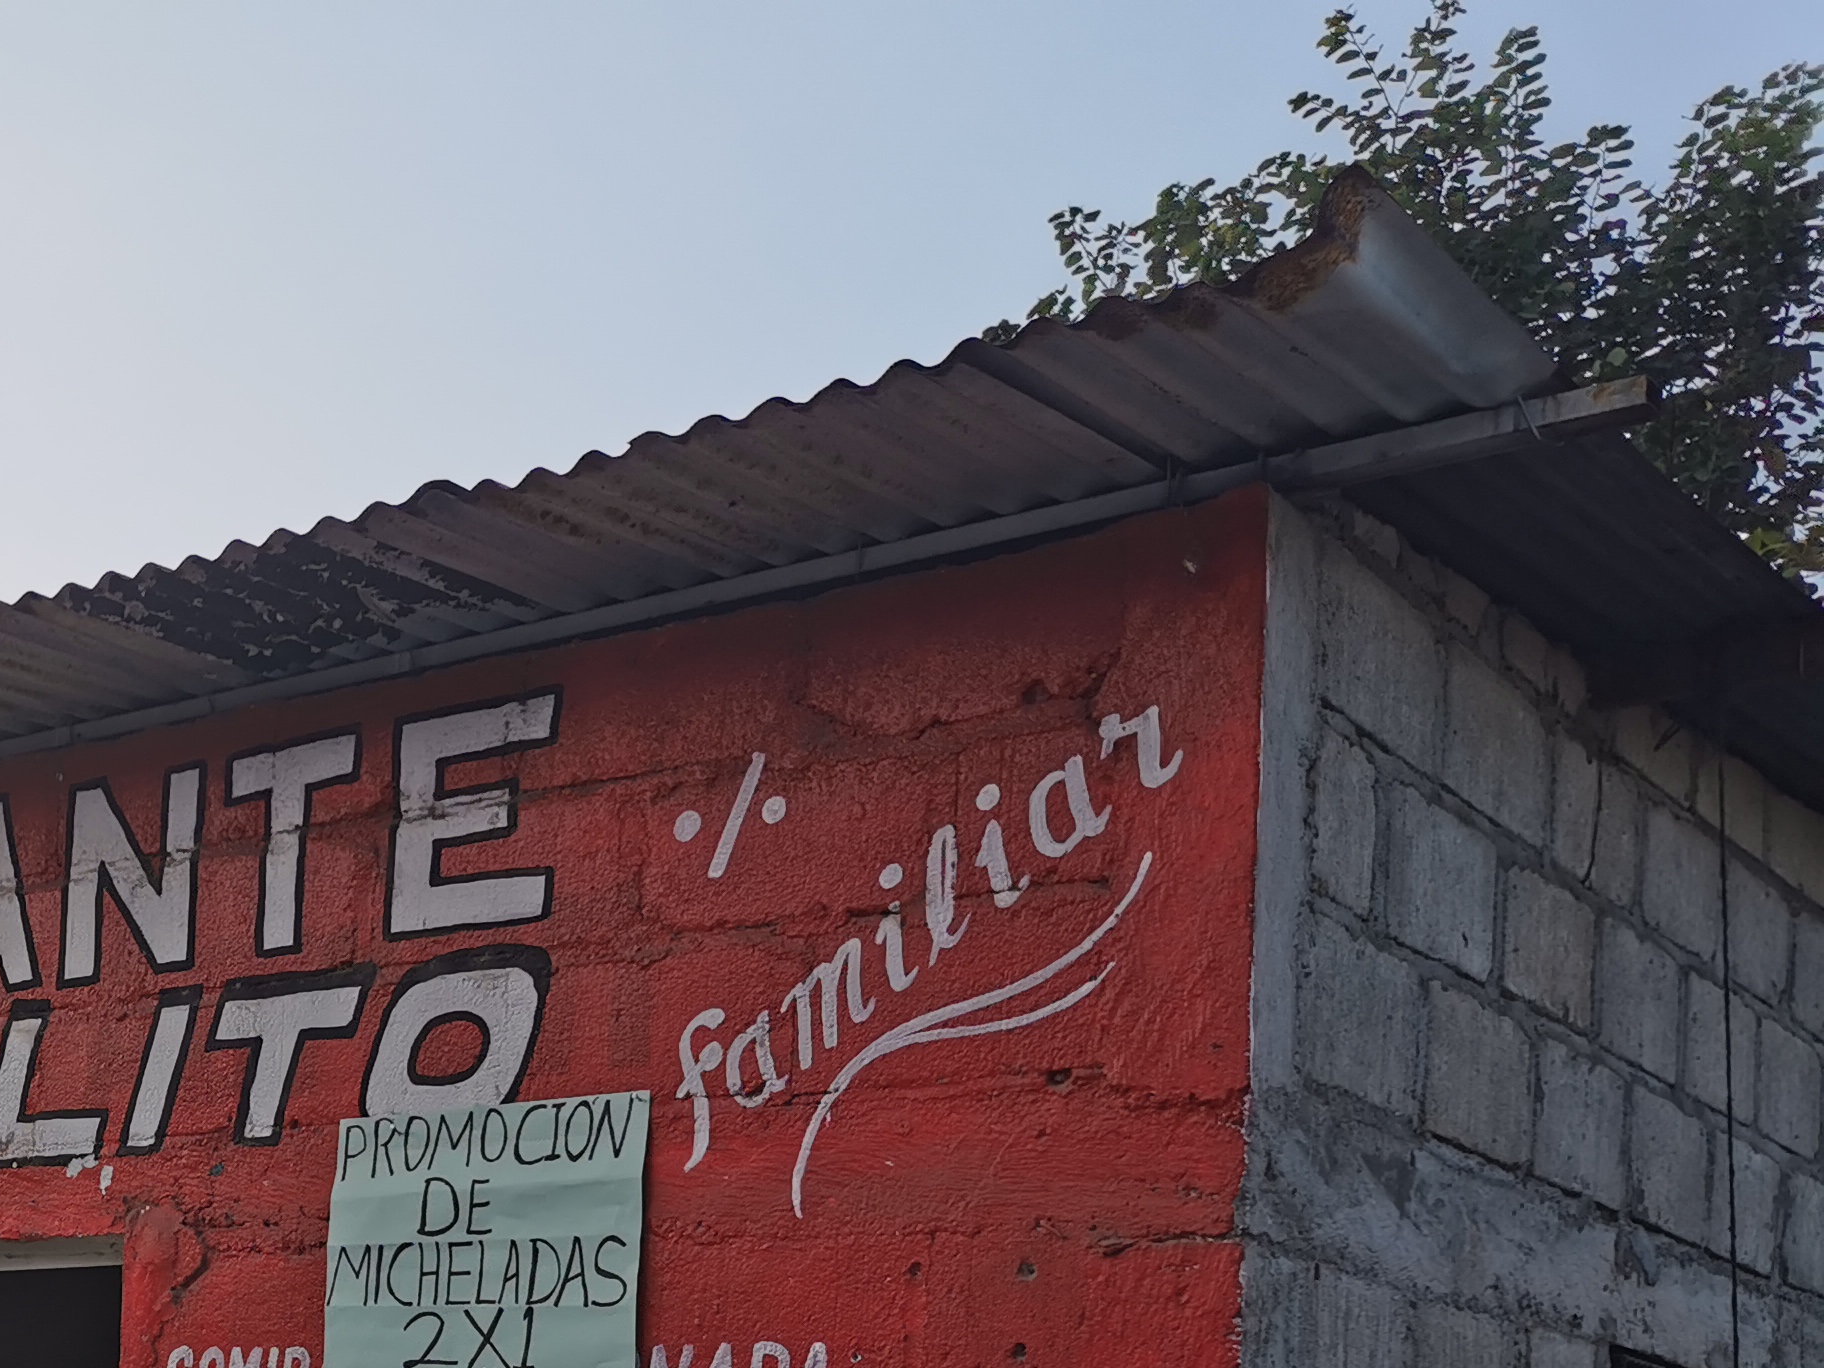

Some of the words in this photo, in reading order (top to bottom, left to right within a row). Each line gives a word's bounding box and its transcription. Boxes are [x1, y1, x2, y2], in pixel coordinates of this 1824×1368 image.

[674, 704, 1184, 1172] familiar
[416, 1177, 493, 1237] DE
[326, 1234, 628, 1308] MICHELADAS
